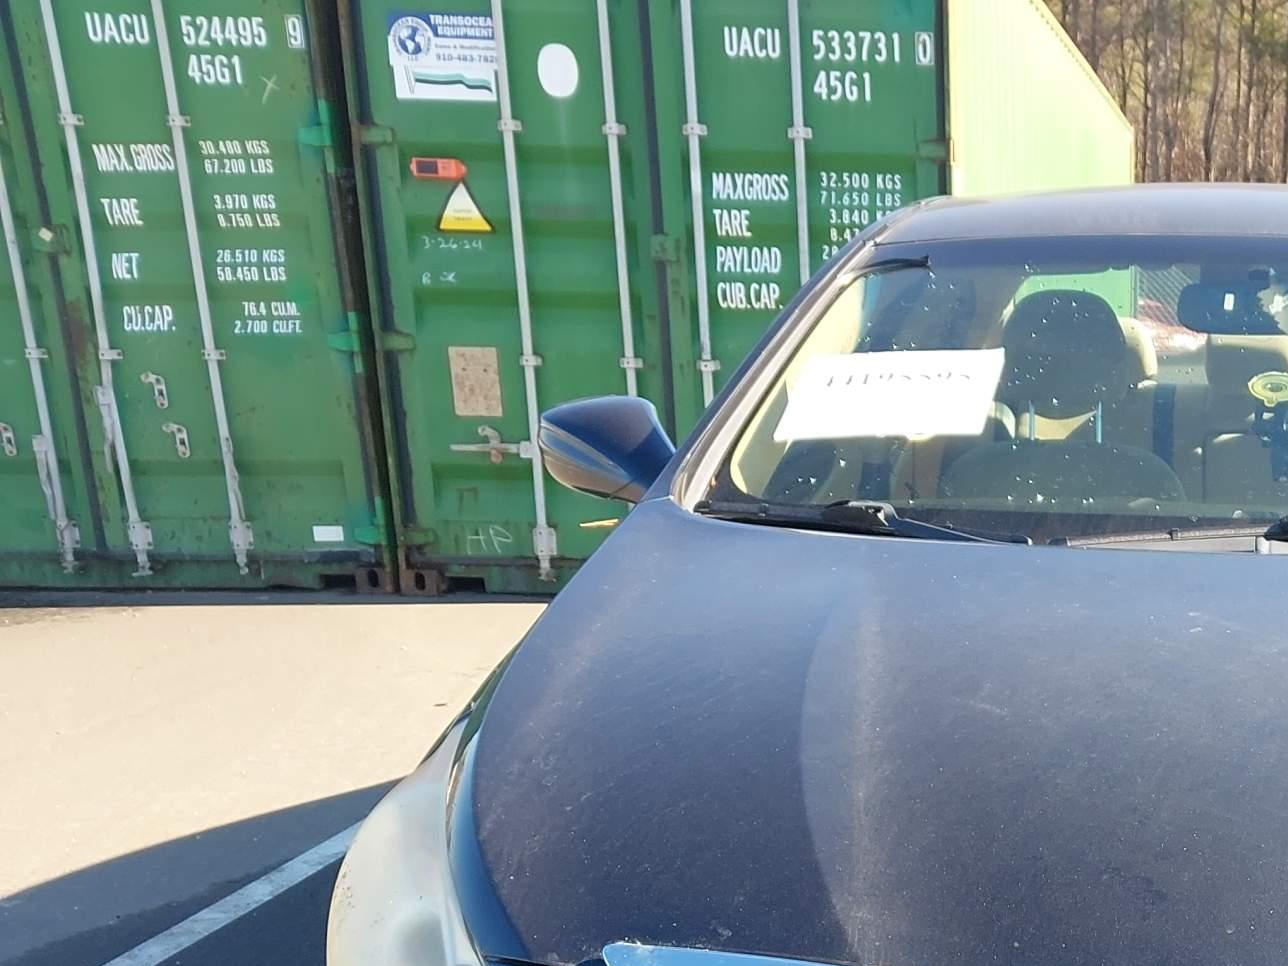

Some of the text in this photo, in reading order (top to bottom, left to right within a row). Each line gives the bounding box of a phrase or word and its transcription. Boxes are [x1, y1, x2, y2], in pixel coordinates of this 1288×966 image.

[85, 12, 303, 46] UACU 524495 9
[429, 15, 493, 26] TRANSOCEA
[724, 27, 780, 58] UACU
[813, 30, 900, 62] 533731
[188, 55, 242, 84] 45G1
[814, 71, 870, 101] 45G1
[92, 143, 175, 171] MAX.GROSS
[245, 140, 269, 154] KGS
[205, 159, 245, 173] 67.200
[821, 172, 901, 190] 32.500 KGS
[214, 194, 275, 209] 3.970 KGS
[821, 191, 901, 207] 71.650 LBS
[100, 198, 143, 225] TARE
[713, 209, 752, 237] TARE
[112, 253, 139, 279] NET
[217, 250, 284, 262] 26.510 KGS
[717, 246, 781, 274] PAYLOAD
[242, 302, 266, 316] 76.4
[235, 320, 267, 333] 2.700
